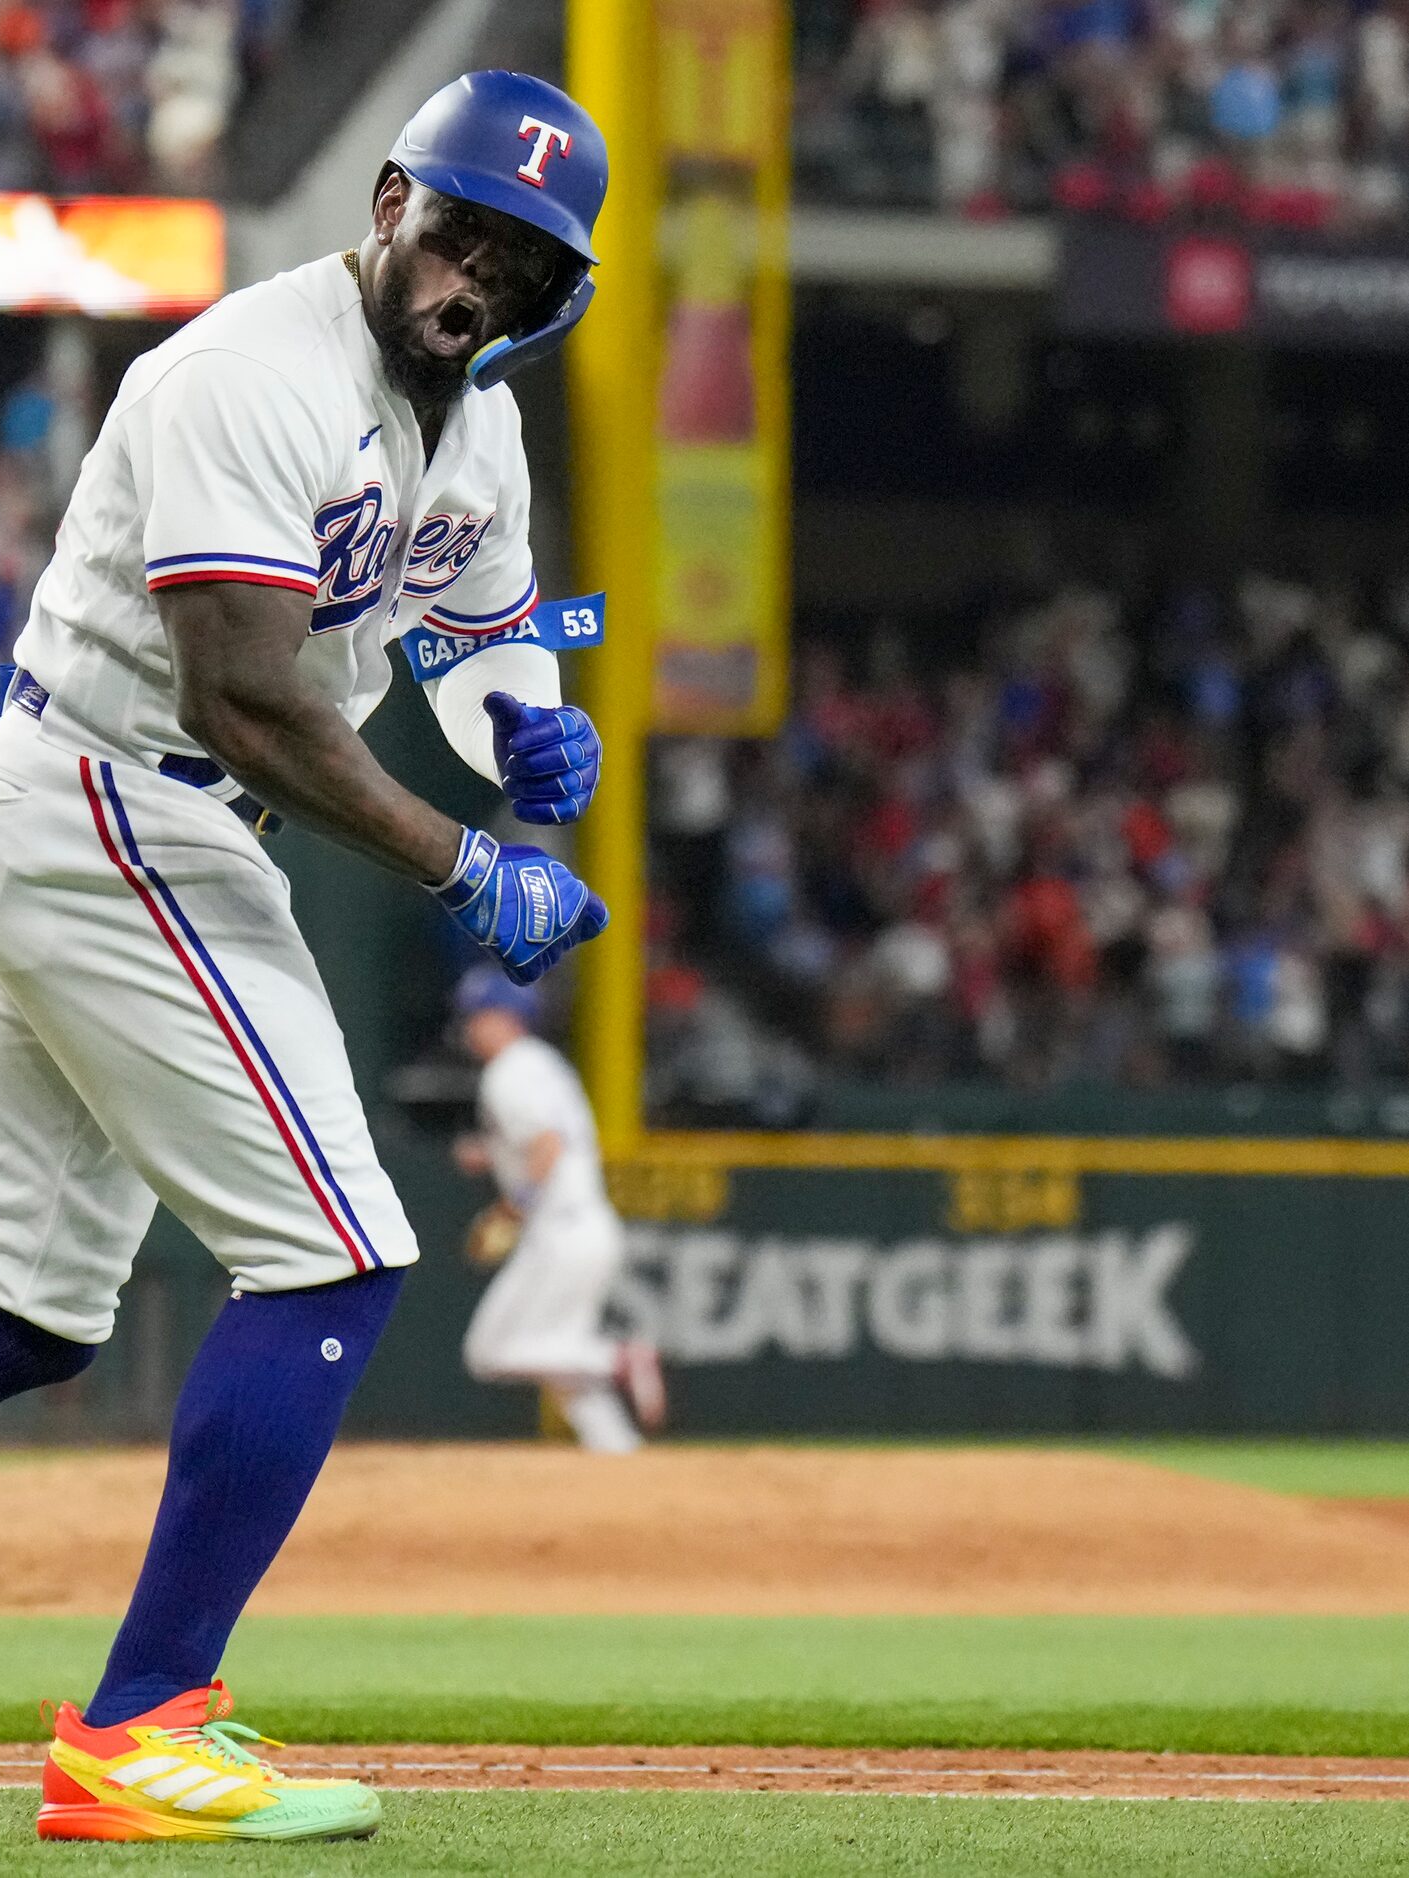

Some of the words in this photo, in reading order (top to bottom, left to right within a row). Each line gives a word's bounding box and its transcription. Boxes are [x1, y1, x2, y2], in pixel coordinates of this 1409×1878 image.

[516, 114, 573, 189] T
[311, 481, 497, 635] Raers
[561, 607, 599, 638] 53
[522, 871, 550, 939] Franklin
[607, 1226, 1198, 1380] SEATGEEK
